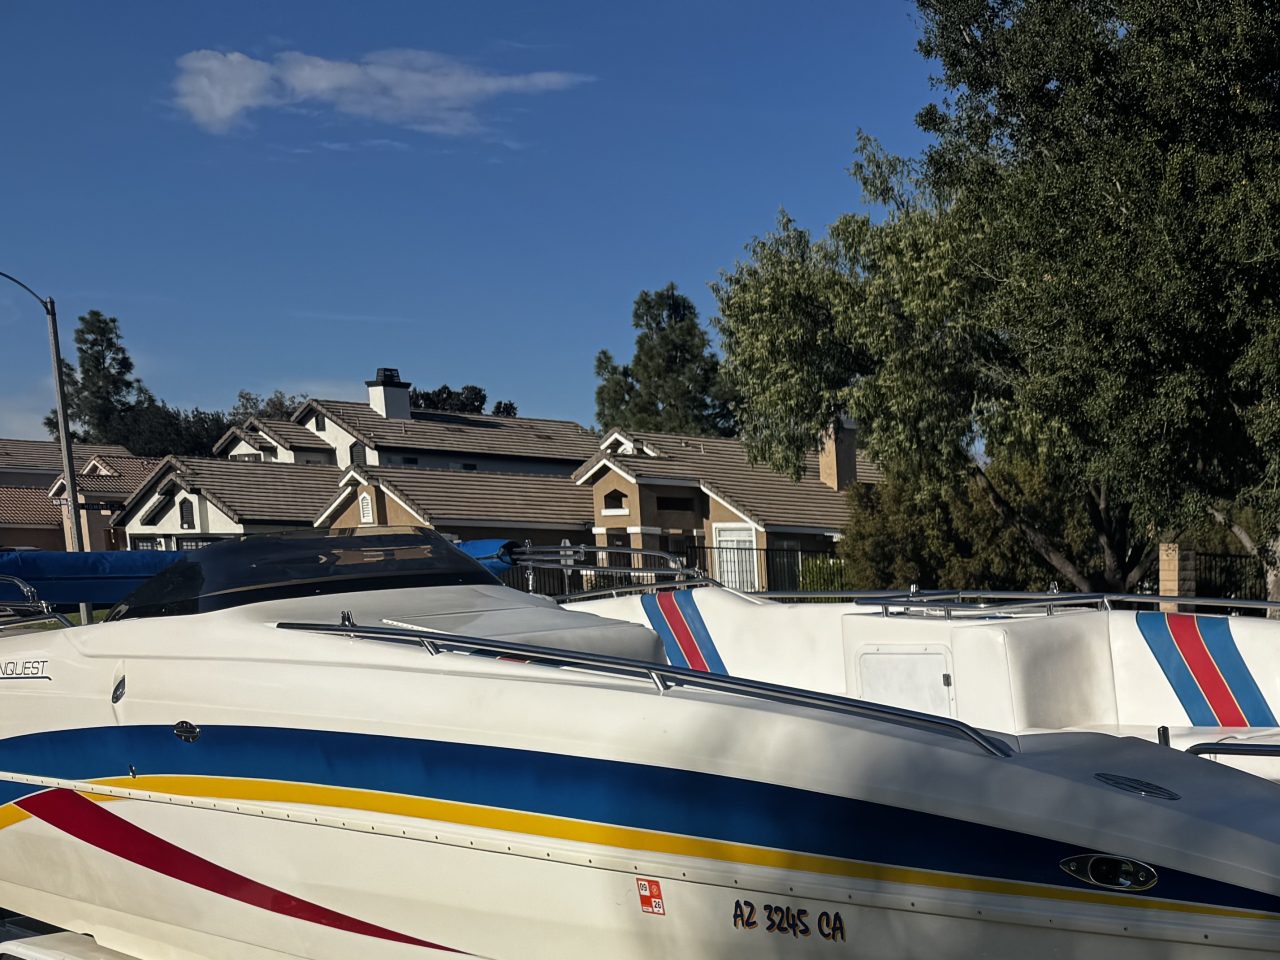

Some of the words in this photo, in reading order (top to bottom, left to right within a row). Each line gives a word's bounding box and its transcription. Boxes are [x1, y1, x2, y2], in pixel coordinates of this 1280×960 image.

[639, 882, 648, 892] 09
[653, 900, 662, 909] 26
[763, 904, 811, 939] 3245
[818, 911, 847, 943] CA
